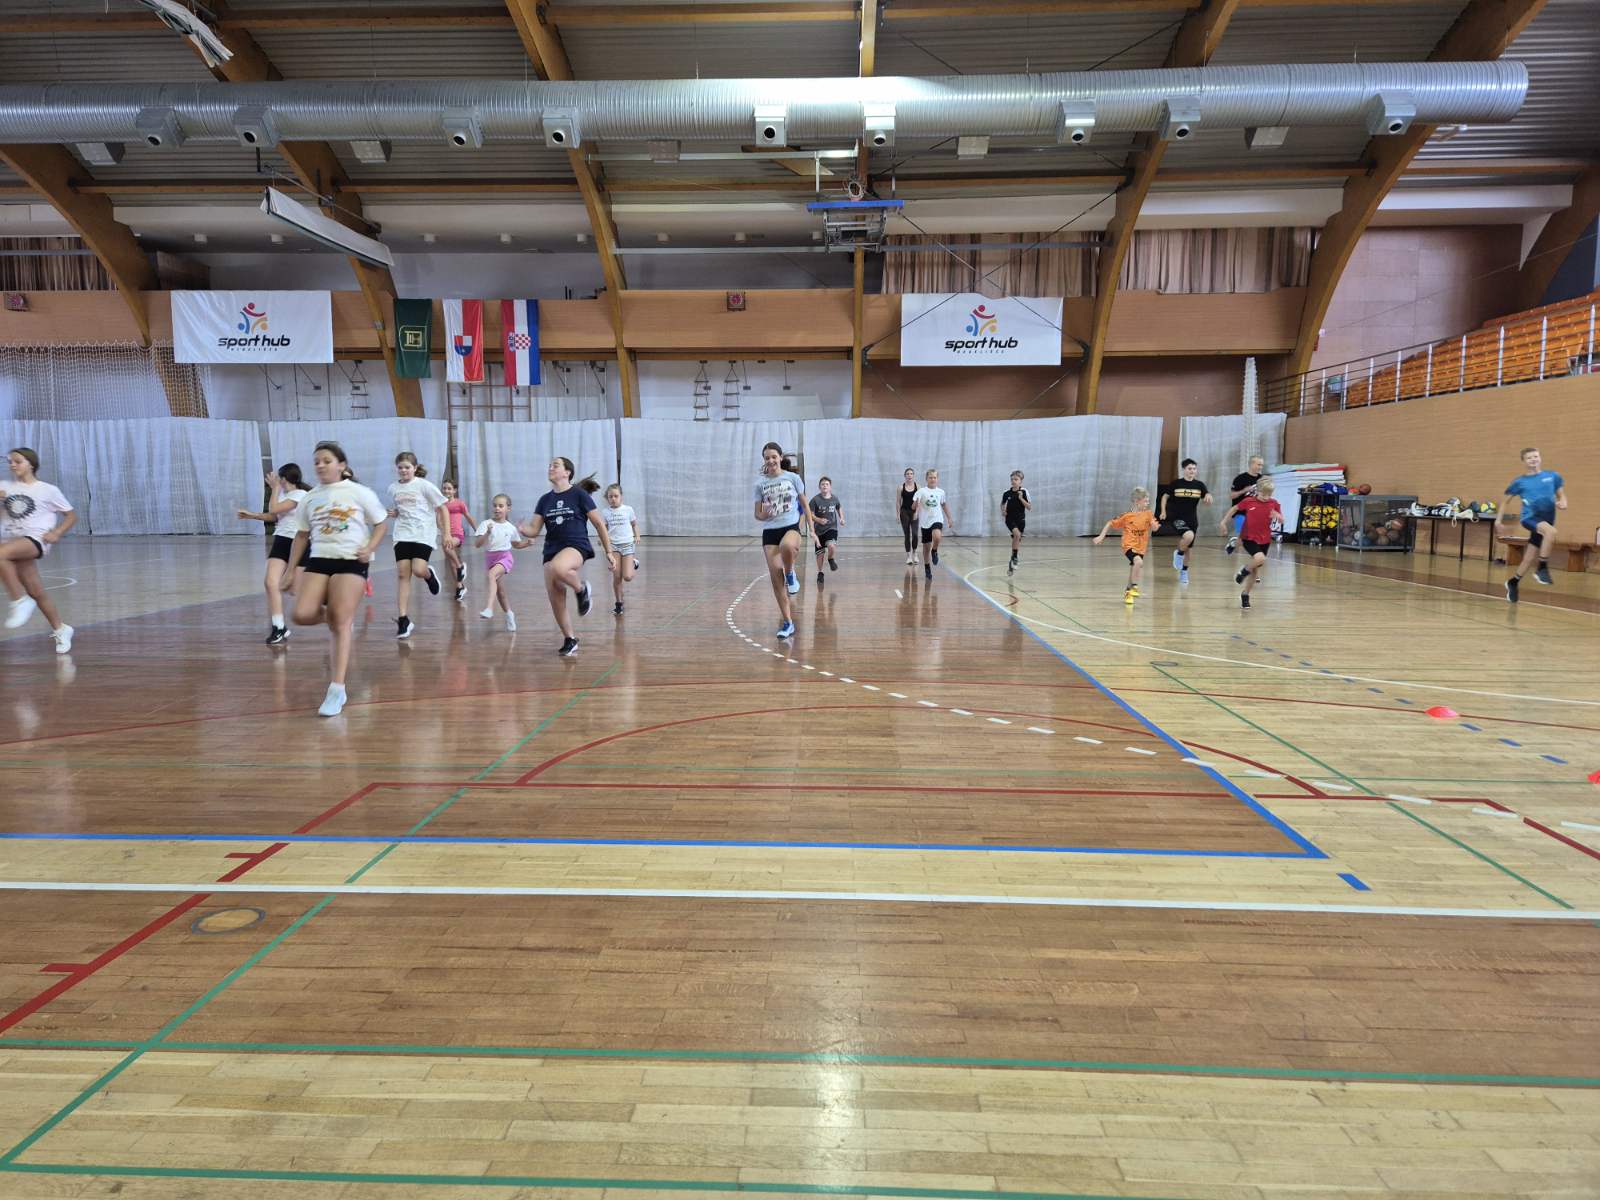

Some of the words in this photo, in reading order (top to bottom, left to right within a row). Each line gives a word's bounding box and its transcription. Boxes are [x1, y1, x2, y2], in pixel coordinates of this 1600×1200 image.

[218, 335, 260, 349] sport
[262, 335, 291, 346] hub
[945, 337, 987, 352] sport
[989, 337, 1018, 348] hub
